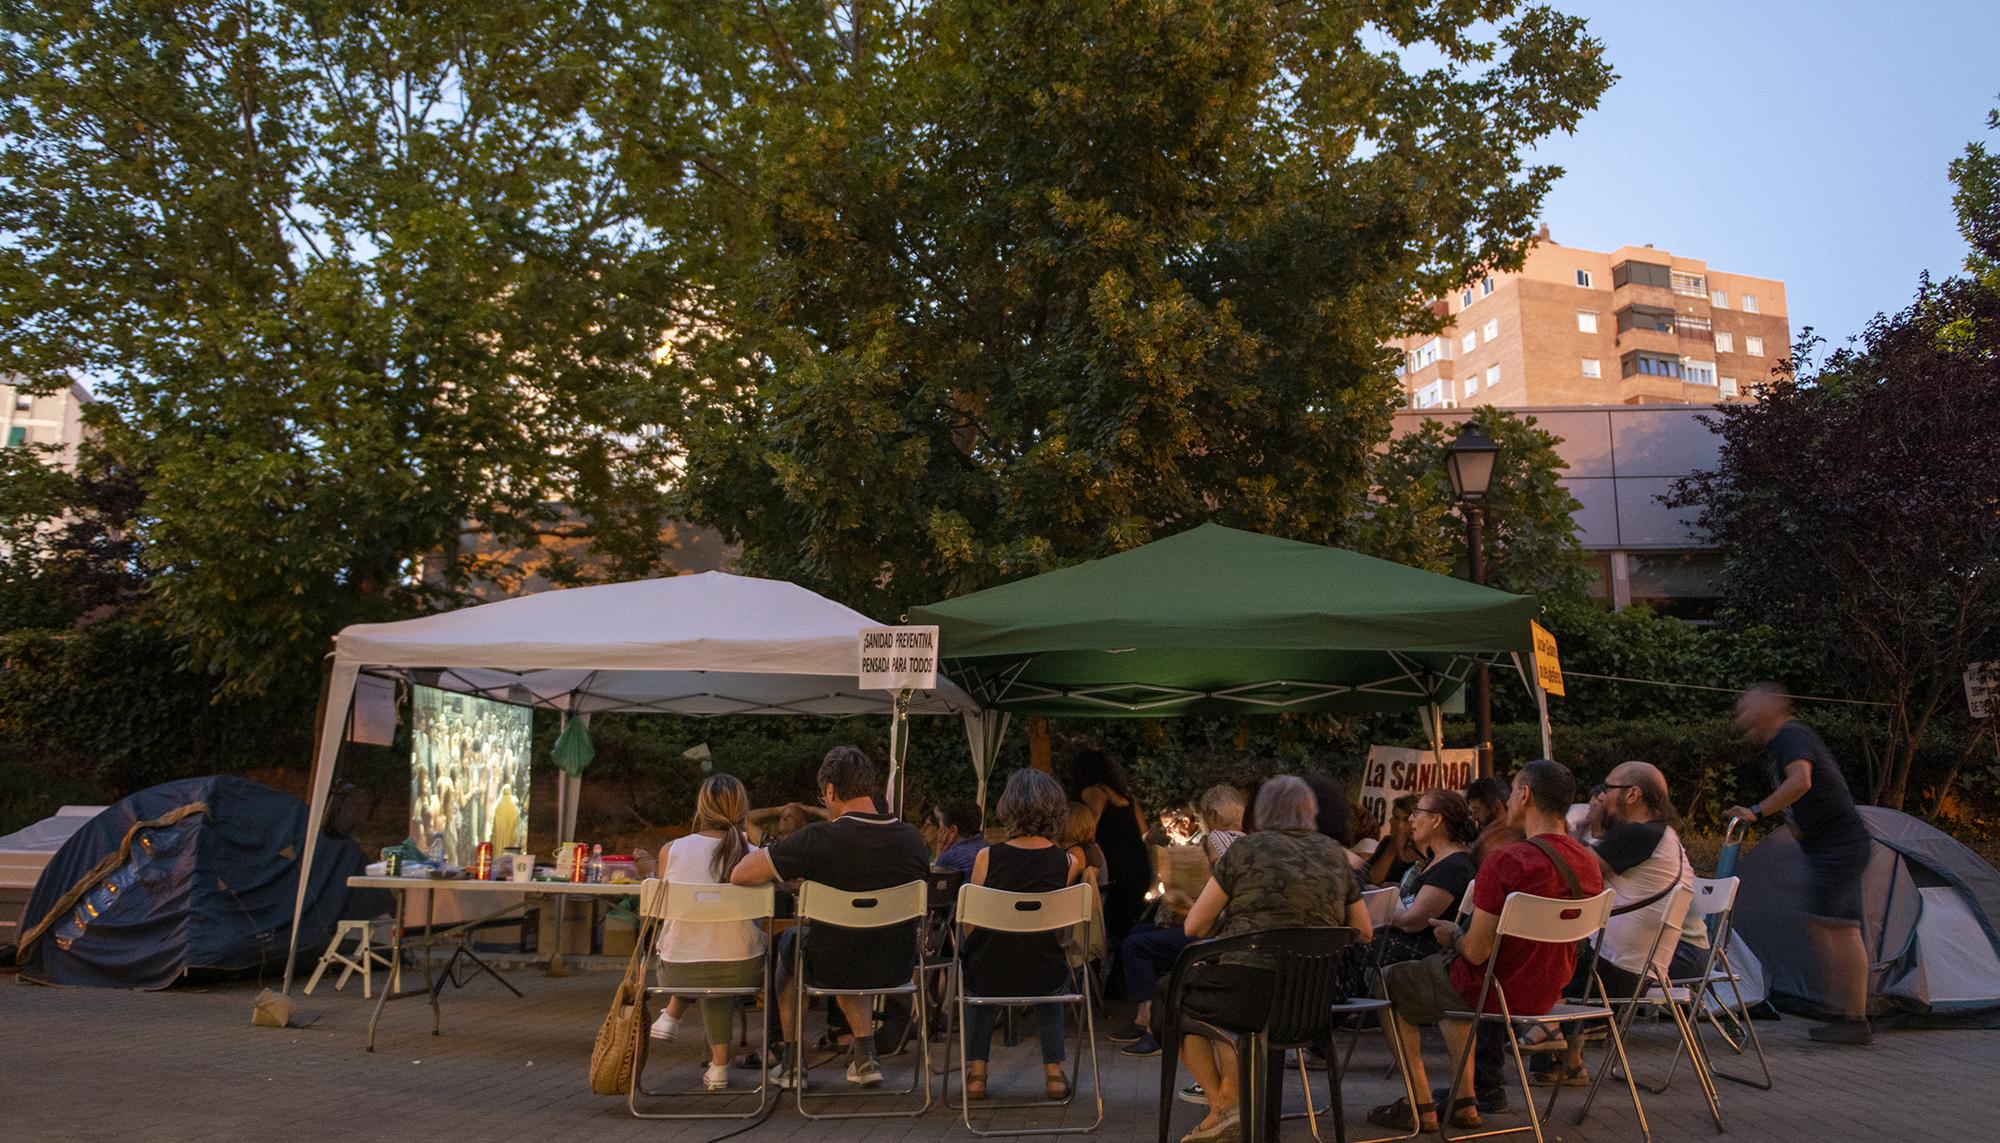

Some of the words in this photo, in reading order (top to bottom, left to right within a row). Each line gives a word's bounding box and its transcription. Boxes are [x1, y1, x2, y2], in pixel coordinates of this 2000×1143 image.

[862, 657, 889, 673] PENSADA
[891, 657, 907, 673] PARA
[1365, 759, 1386, 788] La
[1390, 760, 1471, 792] SANIDAD
